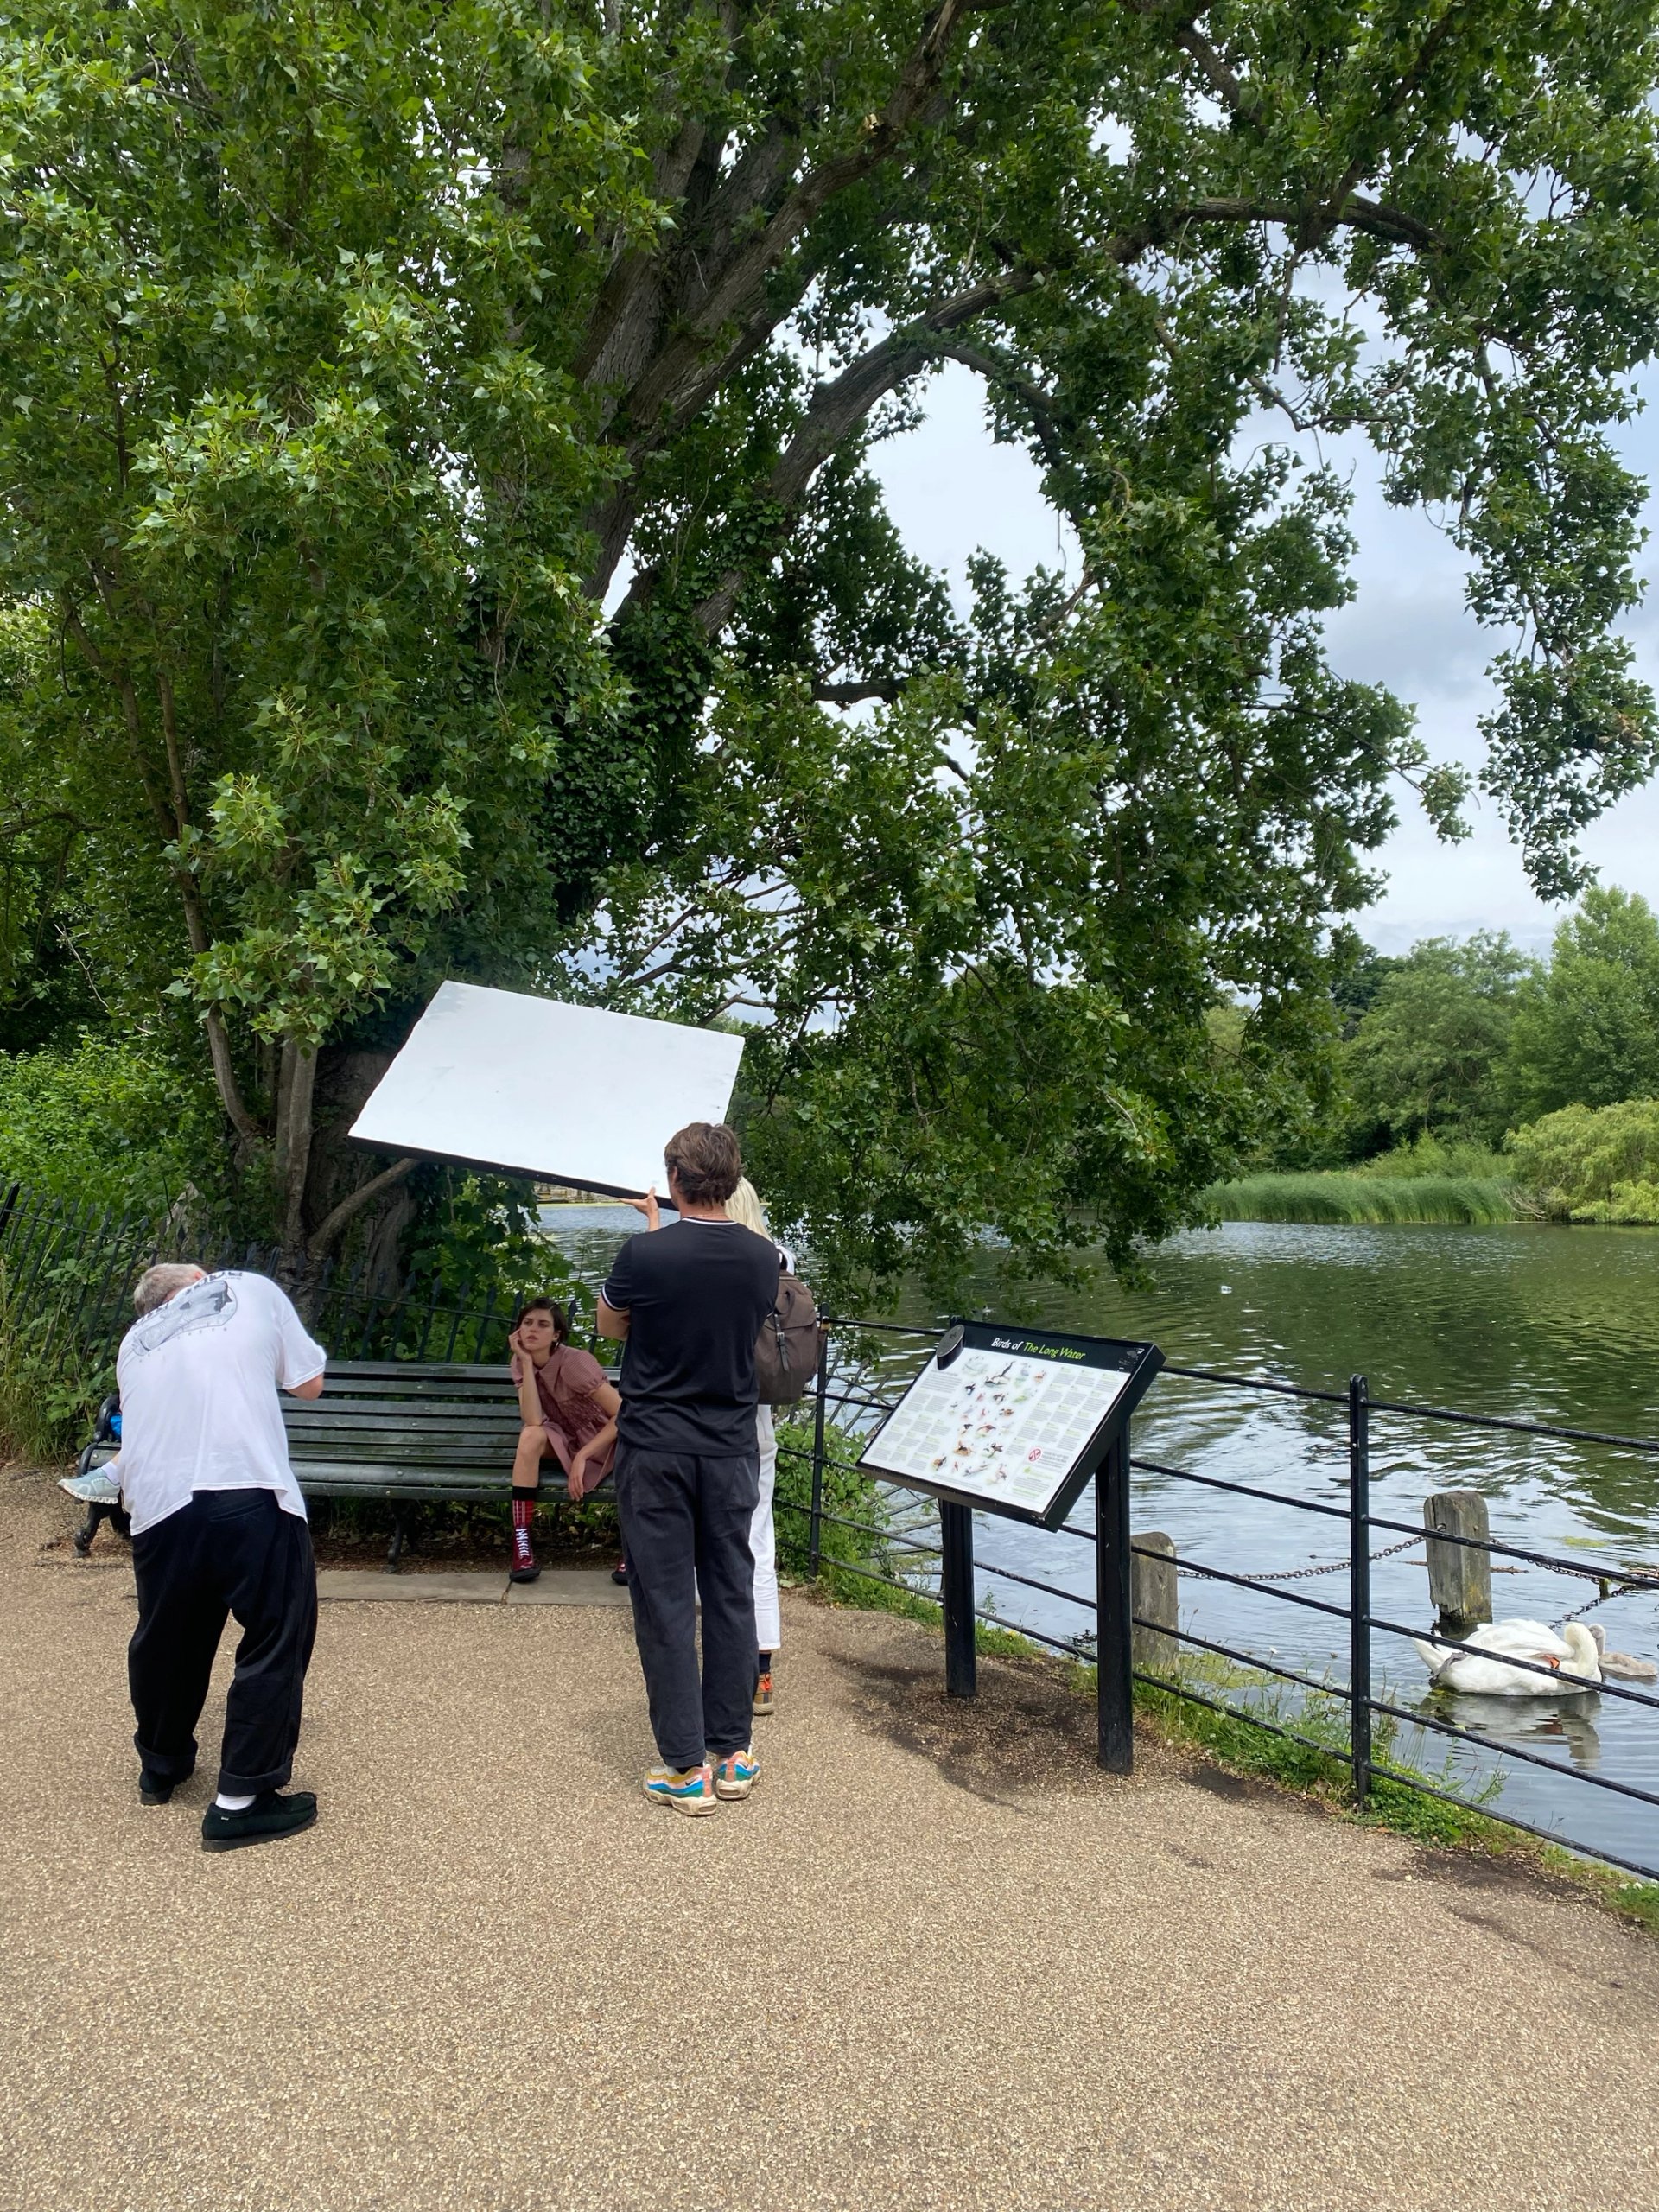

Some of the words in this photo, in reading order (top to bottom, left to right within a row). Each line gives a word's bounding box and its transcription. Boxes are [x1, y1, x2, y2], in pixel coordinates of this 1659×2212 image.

[991, 1338, 1012, 1349] Birds
[1011, 1341, 1023, 1350] of
[1024, 1342, 1039, 1353] The
[1039, 1344, 1059, 1358] Long
[1059, 1348, 1085, 1359] Water
